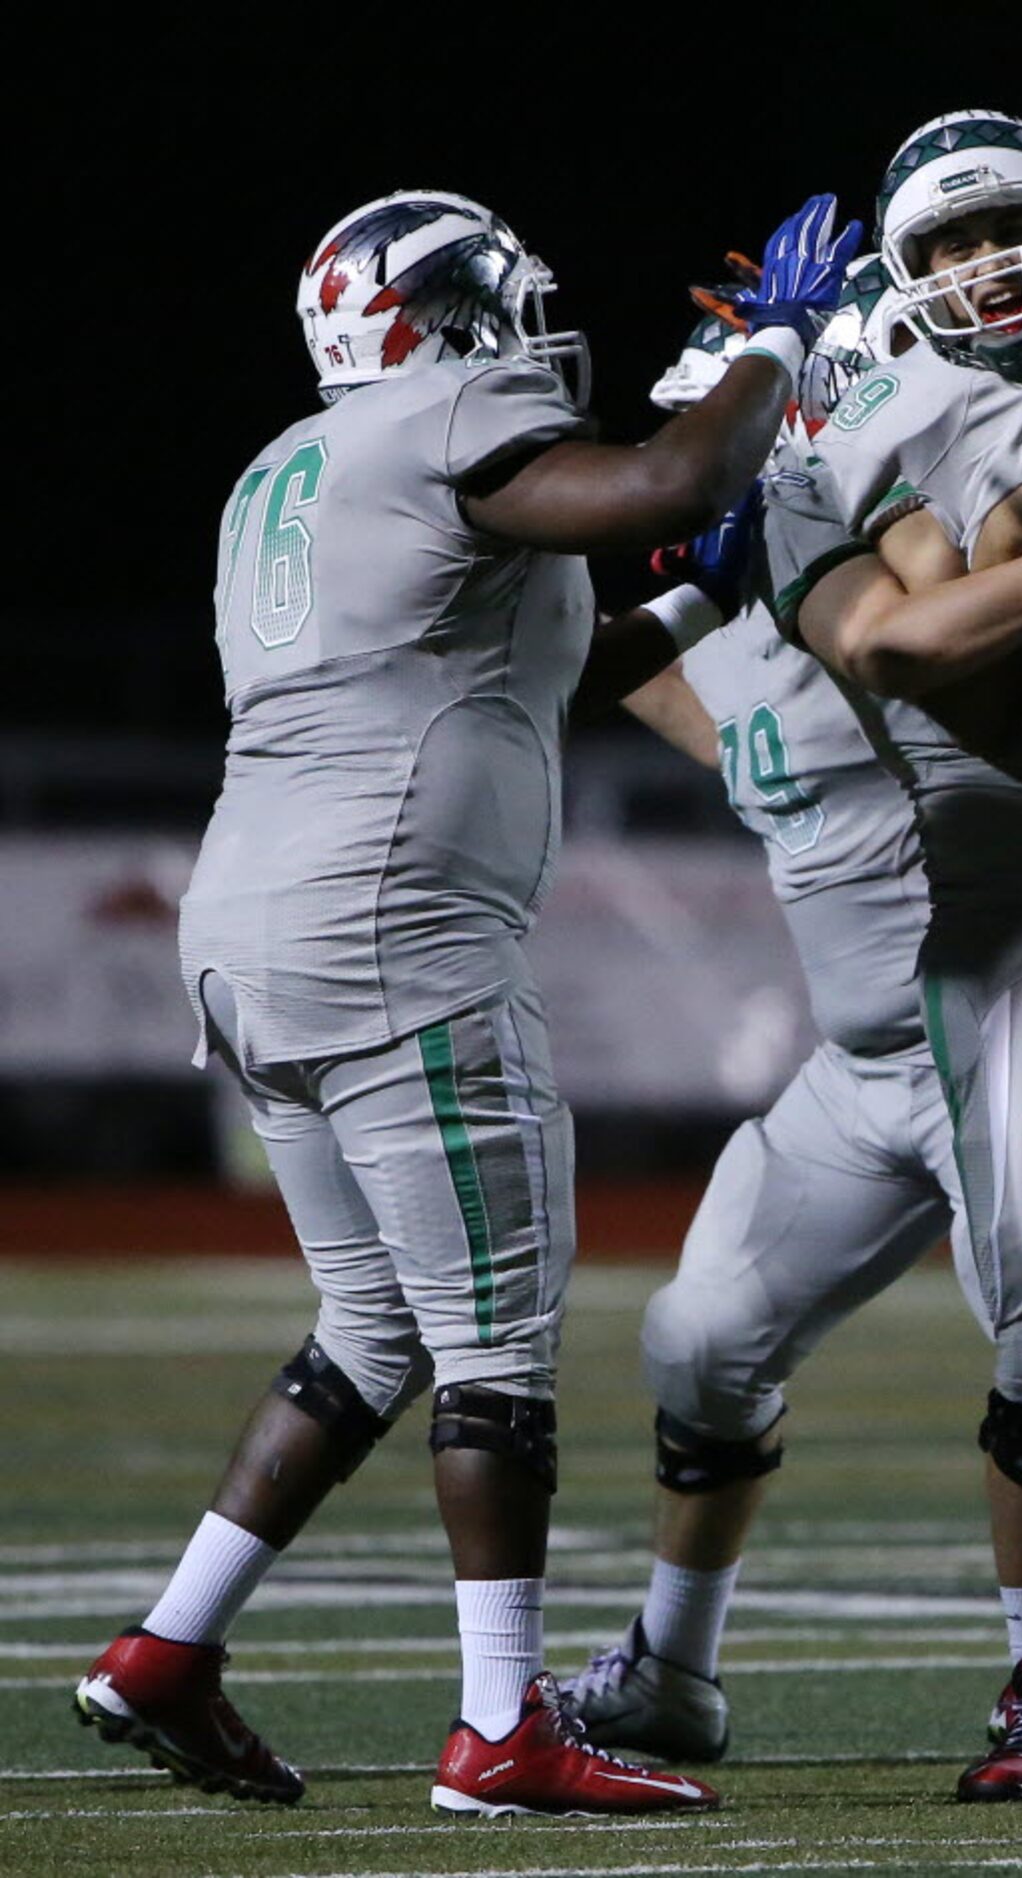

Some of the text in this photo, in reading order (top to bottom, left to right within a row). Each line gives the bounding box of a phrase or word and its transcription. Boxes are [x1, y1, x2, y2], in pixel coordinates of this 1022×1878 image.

[324, 344, 344, 368] 76
[832, 372, 901, 432] 9
[216, 437, 328, 673] 76
[717, 701, 827, 858] 79
